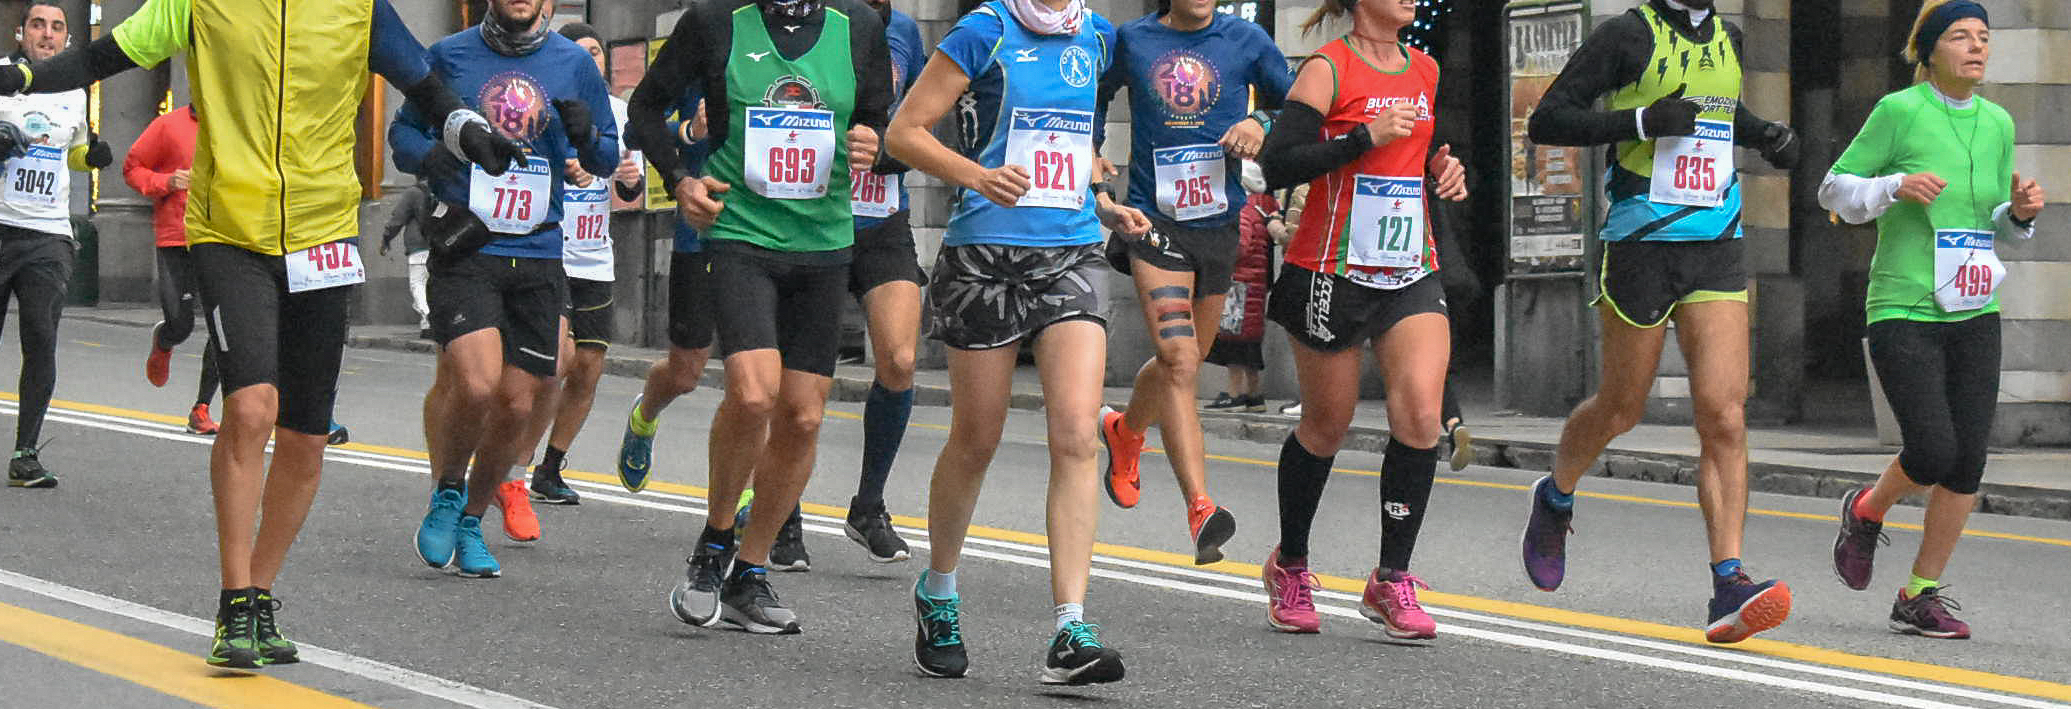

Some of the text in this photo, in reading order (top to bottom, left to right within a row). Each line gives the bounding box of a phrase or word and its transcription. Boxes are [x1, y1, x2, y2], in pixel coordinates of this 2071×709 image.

[14, 168, 55, 196] 3042
[769, 147, 816, 183] 693
[1034, 150, 1075, 191] 621
[1674, 155, 1716, 191] 835
[491, 187, 533, 221] 773
[1174, 175, 1214, 209] 265
[576, 215, 603, 240] 812
[1377, 215, 1413, 252] 127
[1955, 265, 1992, 296] 499
